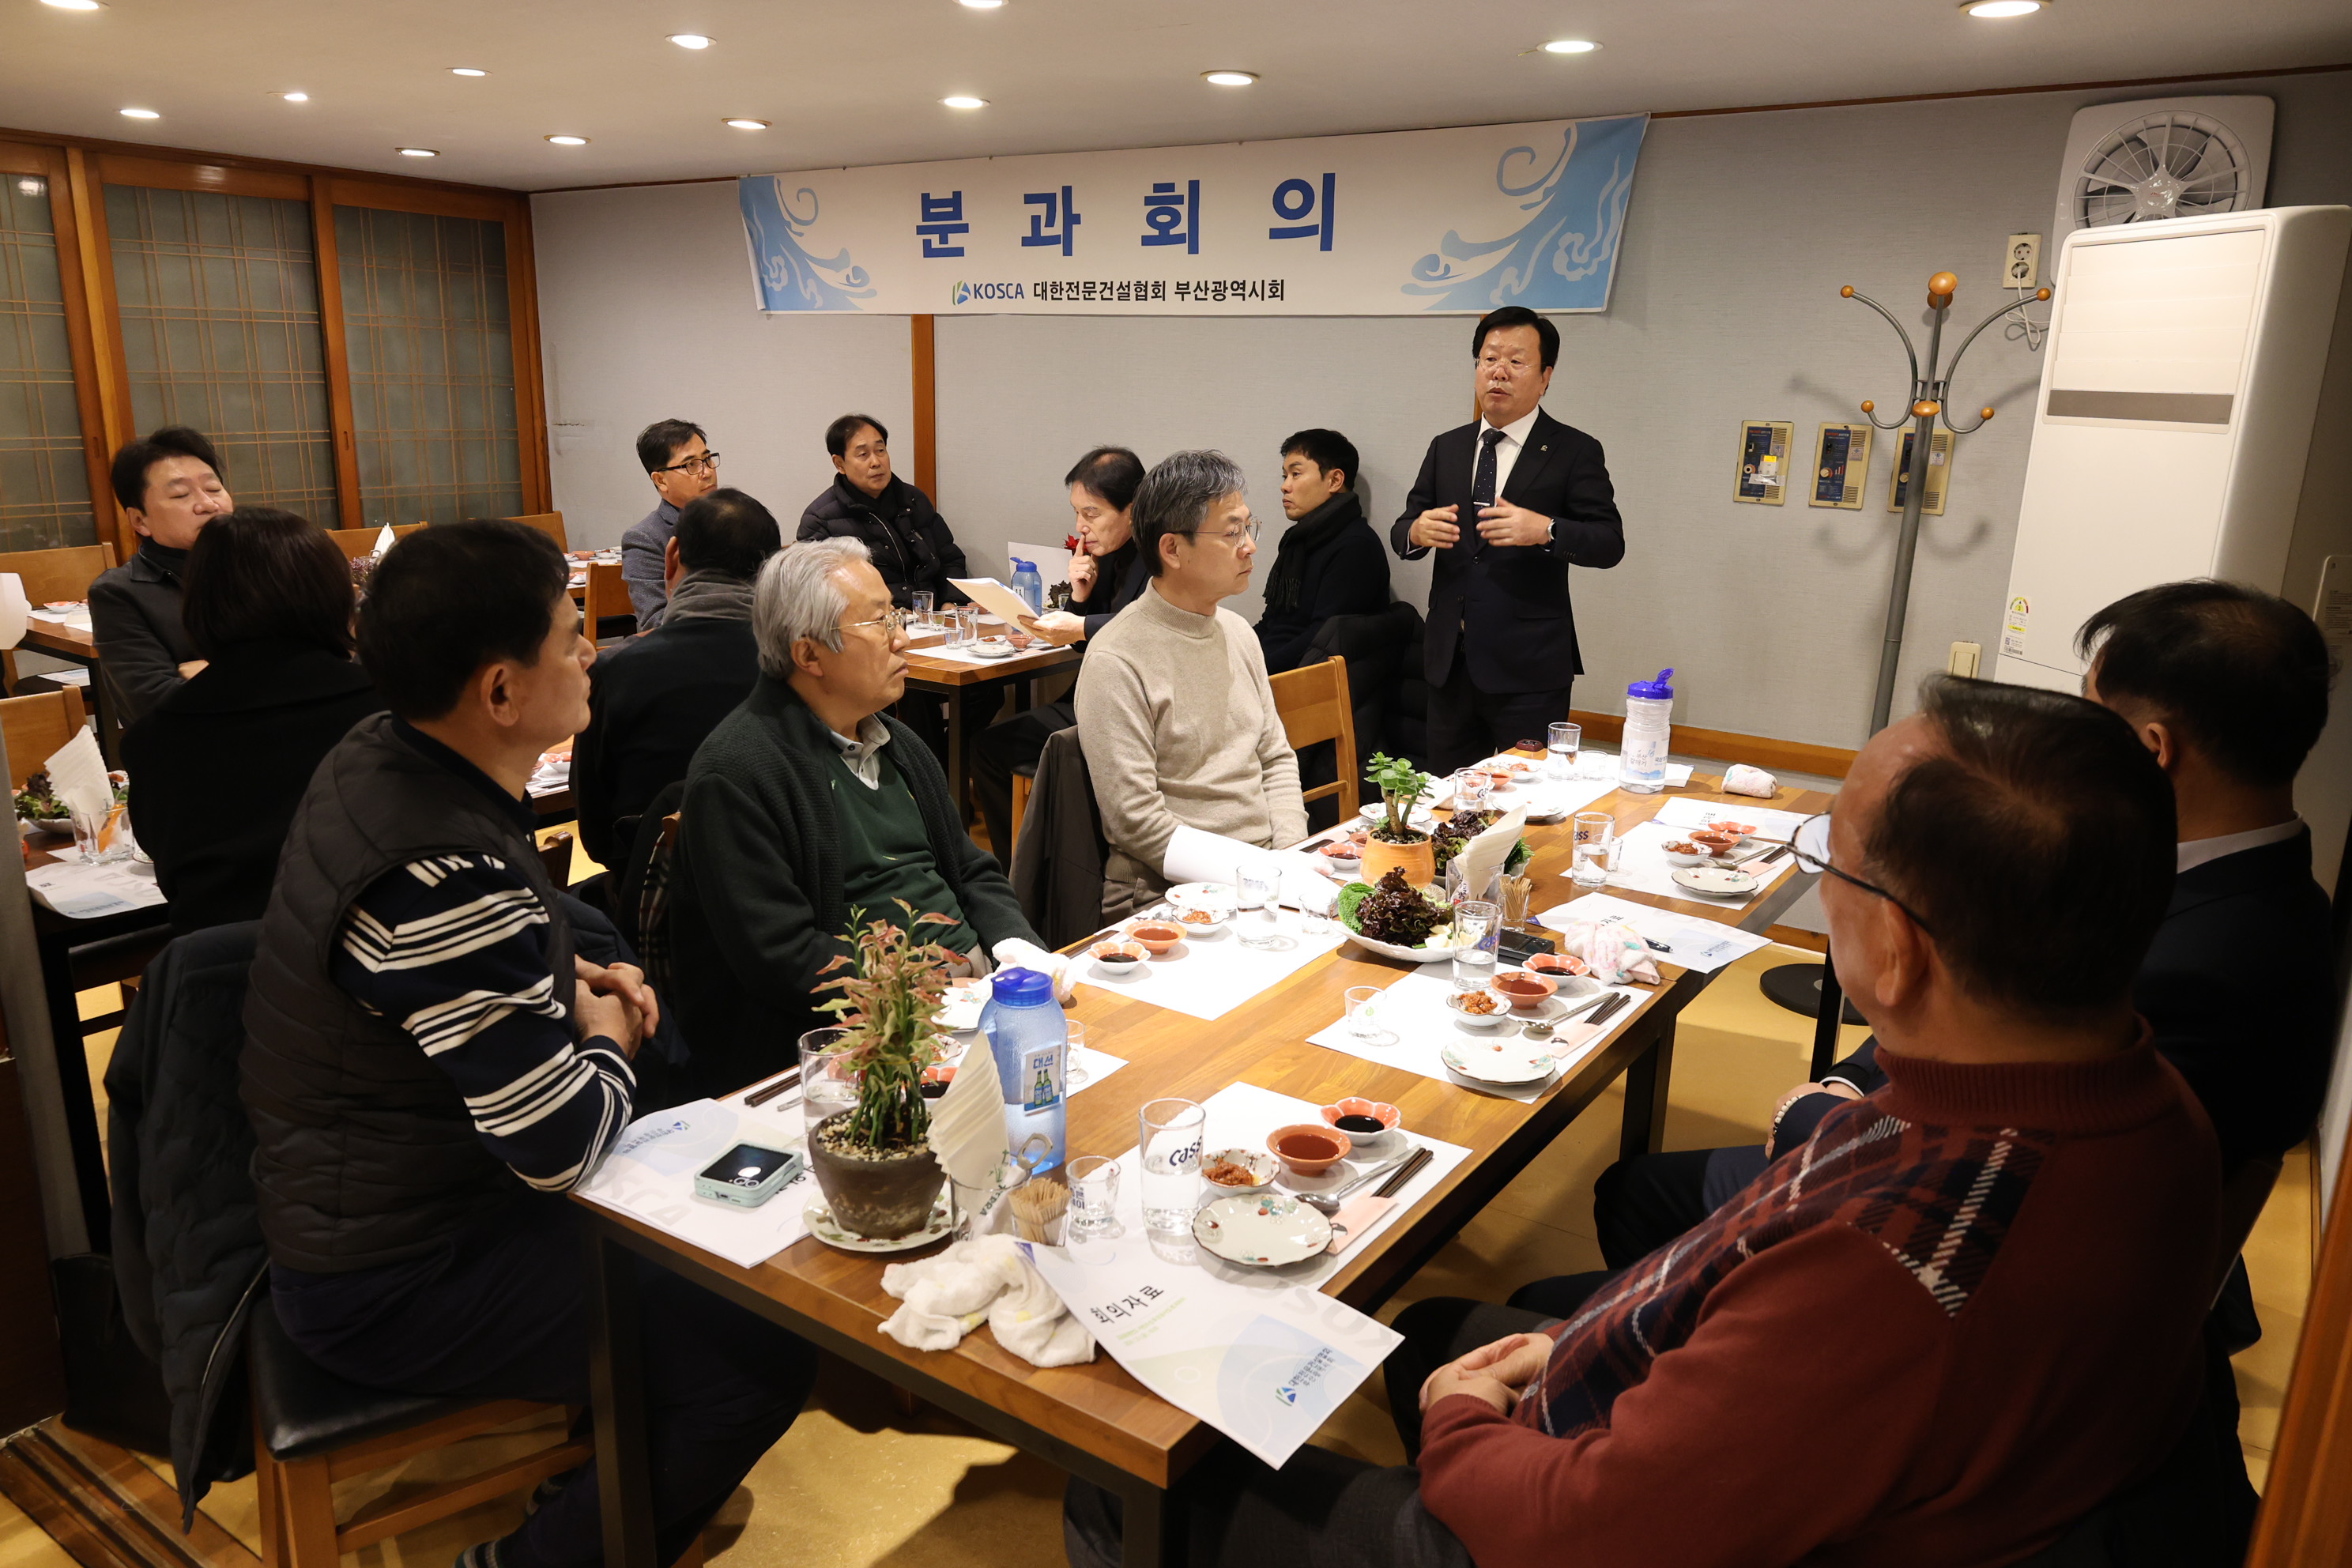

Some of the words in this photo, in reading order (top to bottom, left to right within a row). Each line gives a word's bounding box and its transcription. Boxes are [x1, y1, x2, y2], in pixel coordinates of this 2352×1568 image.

[973, 281, 1025, 300] KOSCA
[1033, 279, 1167, 302] 대한전문건설협회
[1174, 278, 1286, 302] 부산광역시회
[1574, 830, 1589, 841] ass
[1033, 1054, 1054, 1069] 대선
[1169, 1135, 1202, 1167] Cass
[1090, 1285, 1165, 1325] 회의자료
